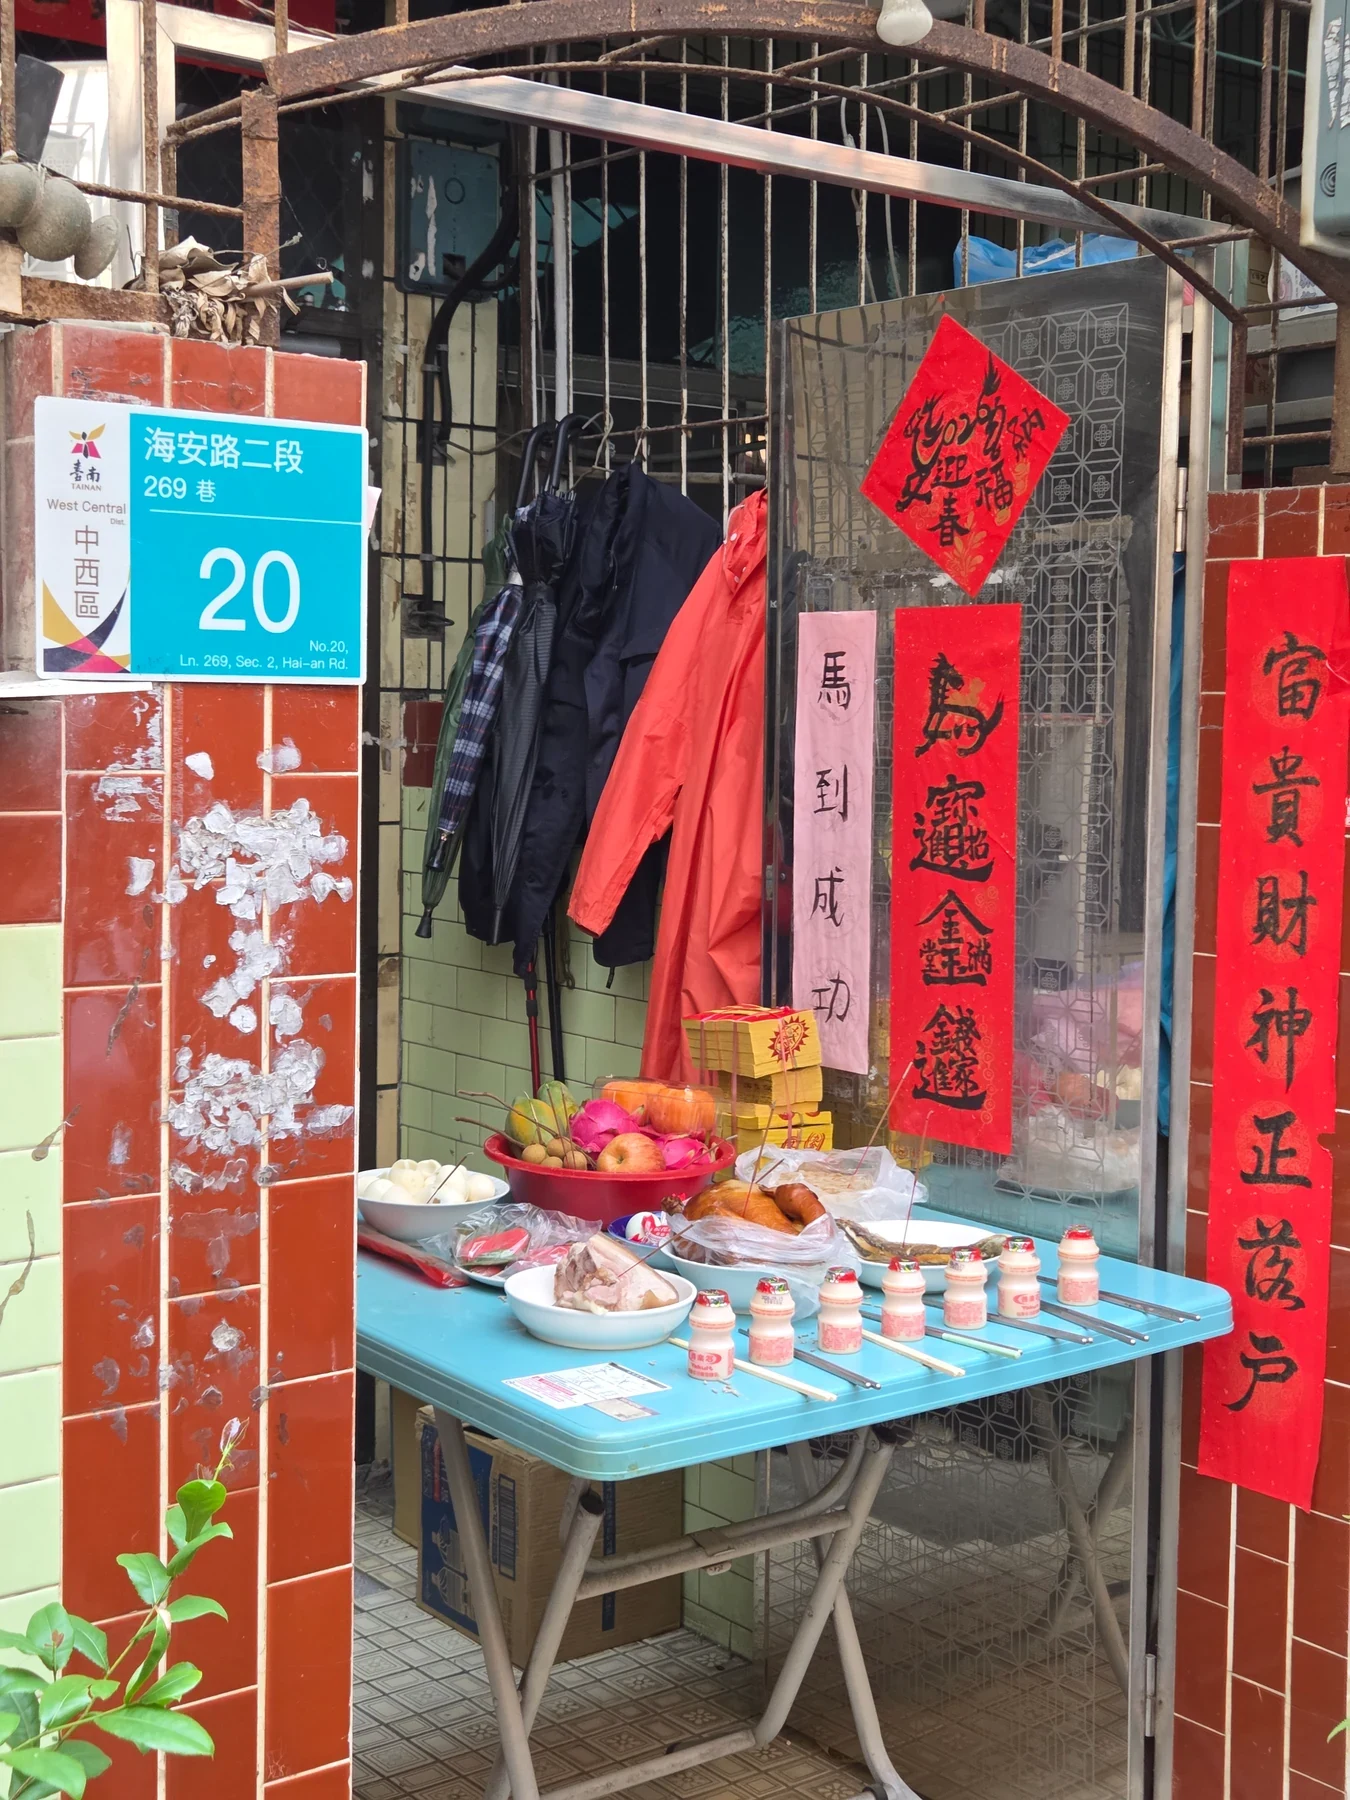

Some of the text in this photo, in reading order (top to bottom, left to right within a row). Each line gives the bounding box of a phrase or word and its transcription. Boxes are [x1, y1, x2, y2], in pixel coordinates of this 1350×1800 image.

[144, 427, 304, 474] 海安路二段
[974, 407, 1046, 512] 納福
[46, 498, 126, 515] West Central
[71, 483, 102, 492] TAINAN
[143, 476, 216, 503] 269 巷
[928, 454, 972, 547] 迎春
[110, 518, 126, 526] Dist.
[74, 525, 100, 619] 中西區
[199, 546, 301, 634] 20
[180, 655, 349, 670] Ln. 269, Sec. 2, Hai-an Rd.
[808, 651, 852, 1025] 馬到成功
